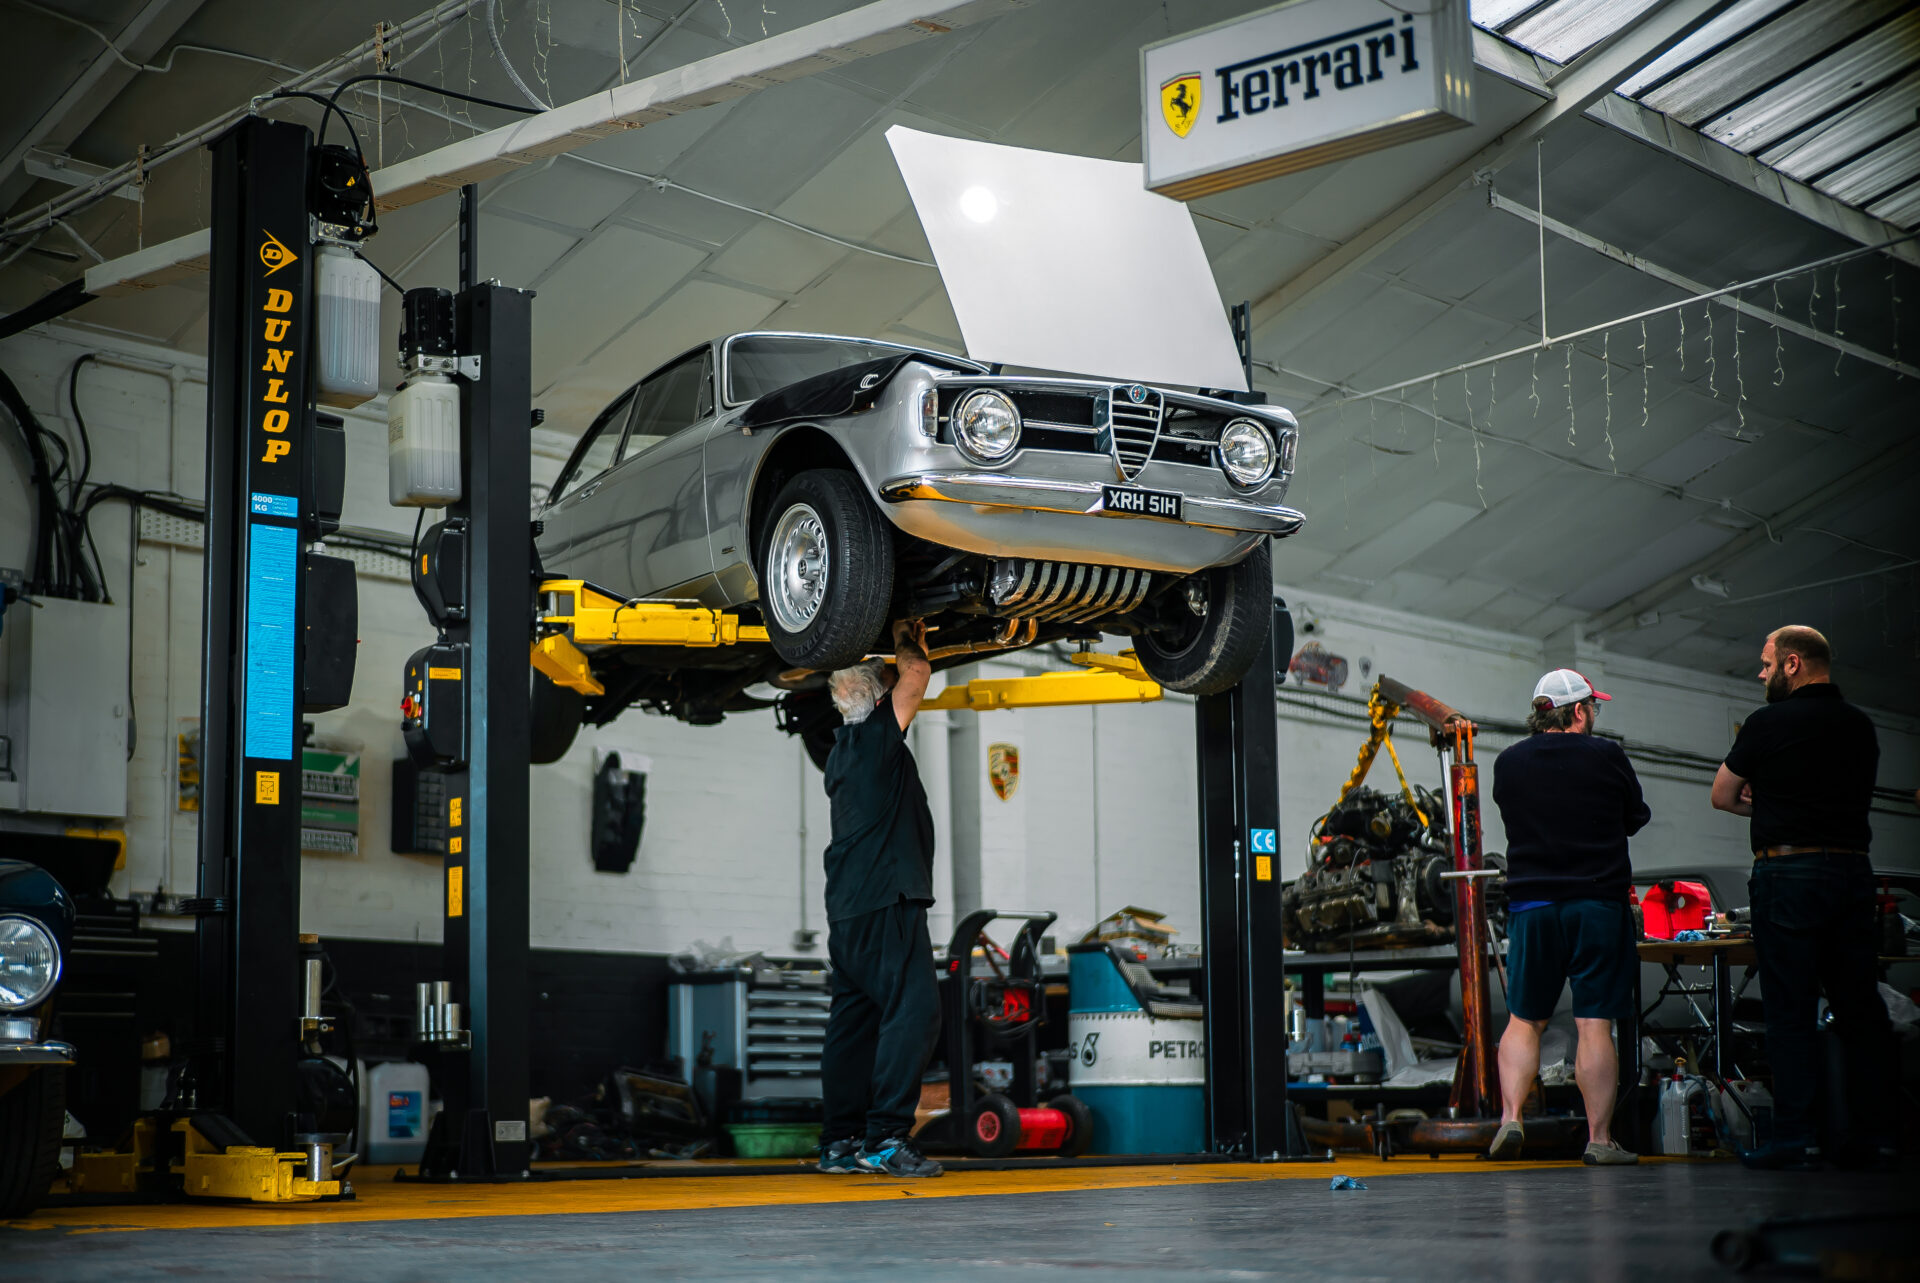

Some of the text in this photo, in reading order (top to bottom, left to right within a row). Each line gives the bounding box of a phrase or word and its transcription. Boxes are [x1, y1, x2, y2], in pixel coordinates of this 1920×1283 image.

[1215, 13, 1419, 123] Ferrari
[261, 288, 294, 464] DUNLOP
[252, 494, 273, 504] 4000
[254, 503, 268, 512] KG
[1109, 490, 1176, 515] XRH 51H
[1253, 831, 1274, 850] CE
